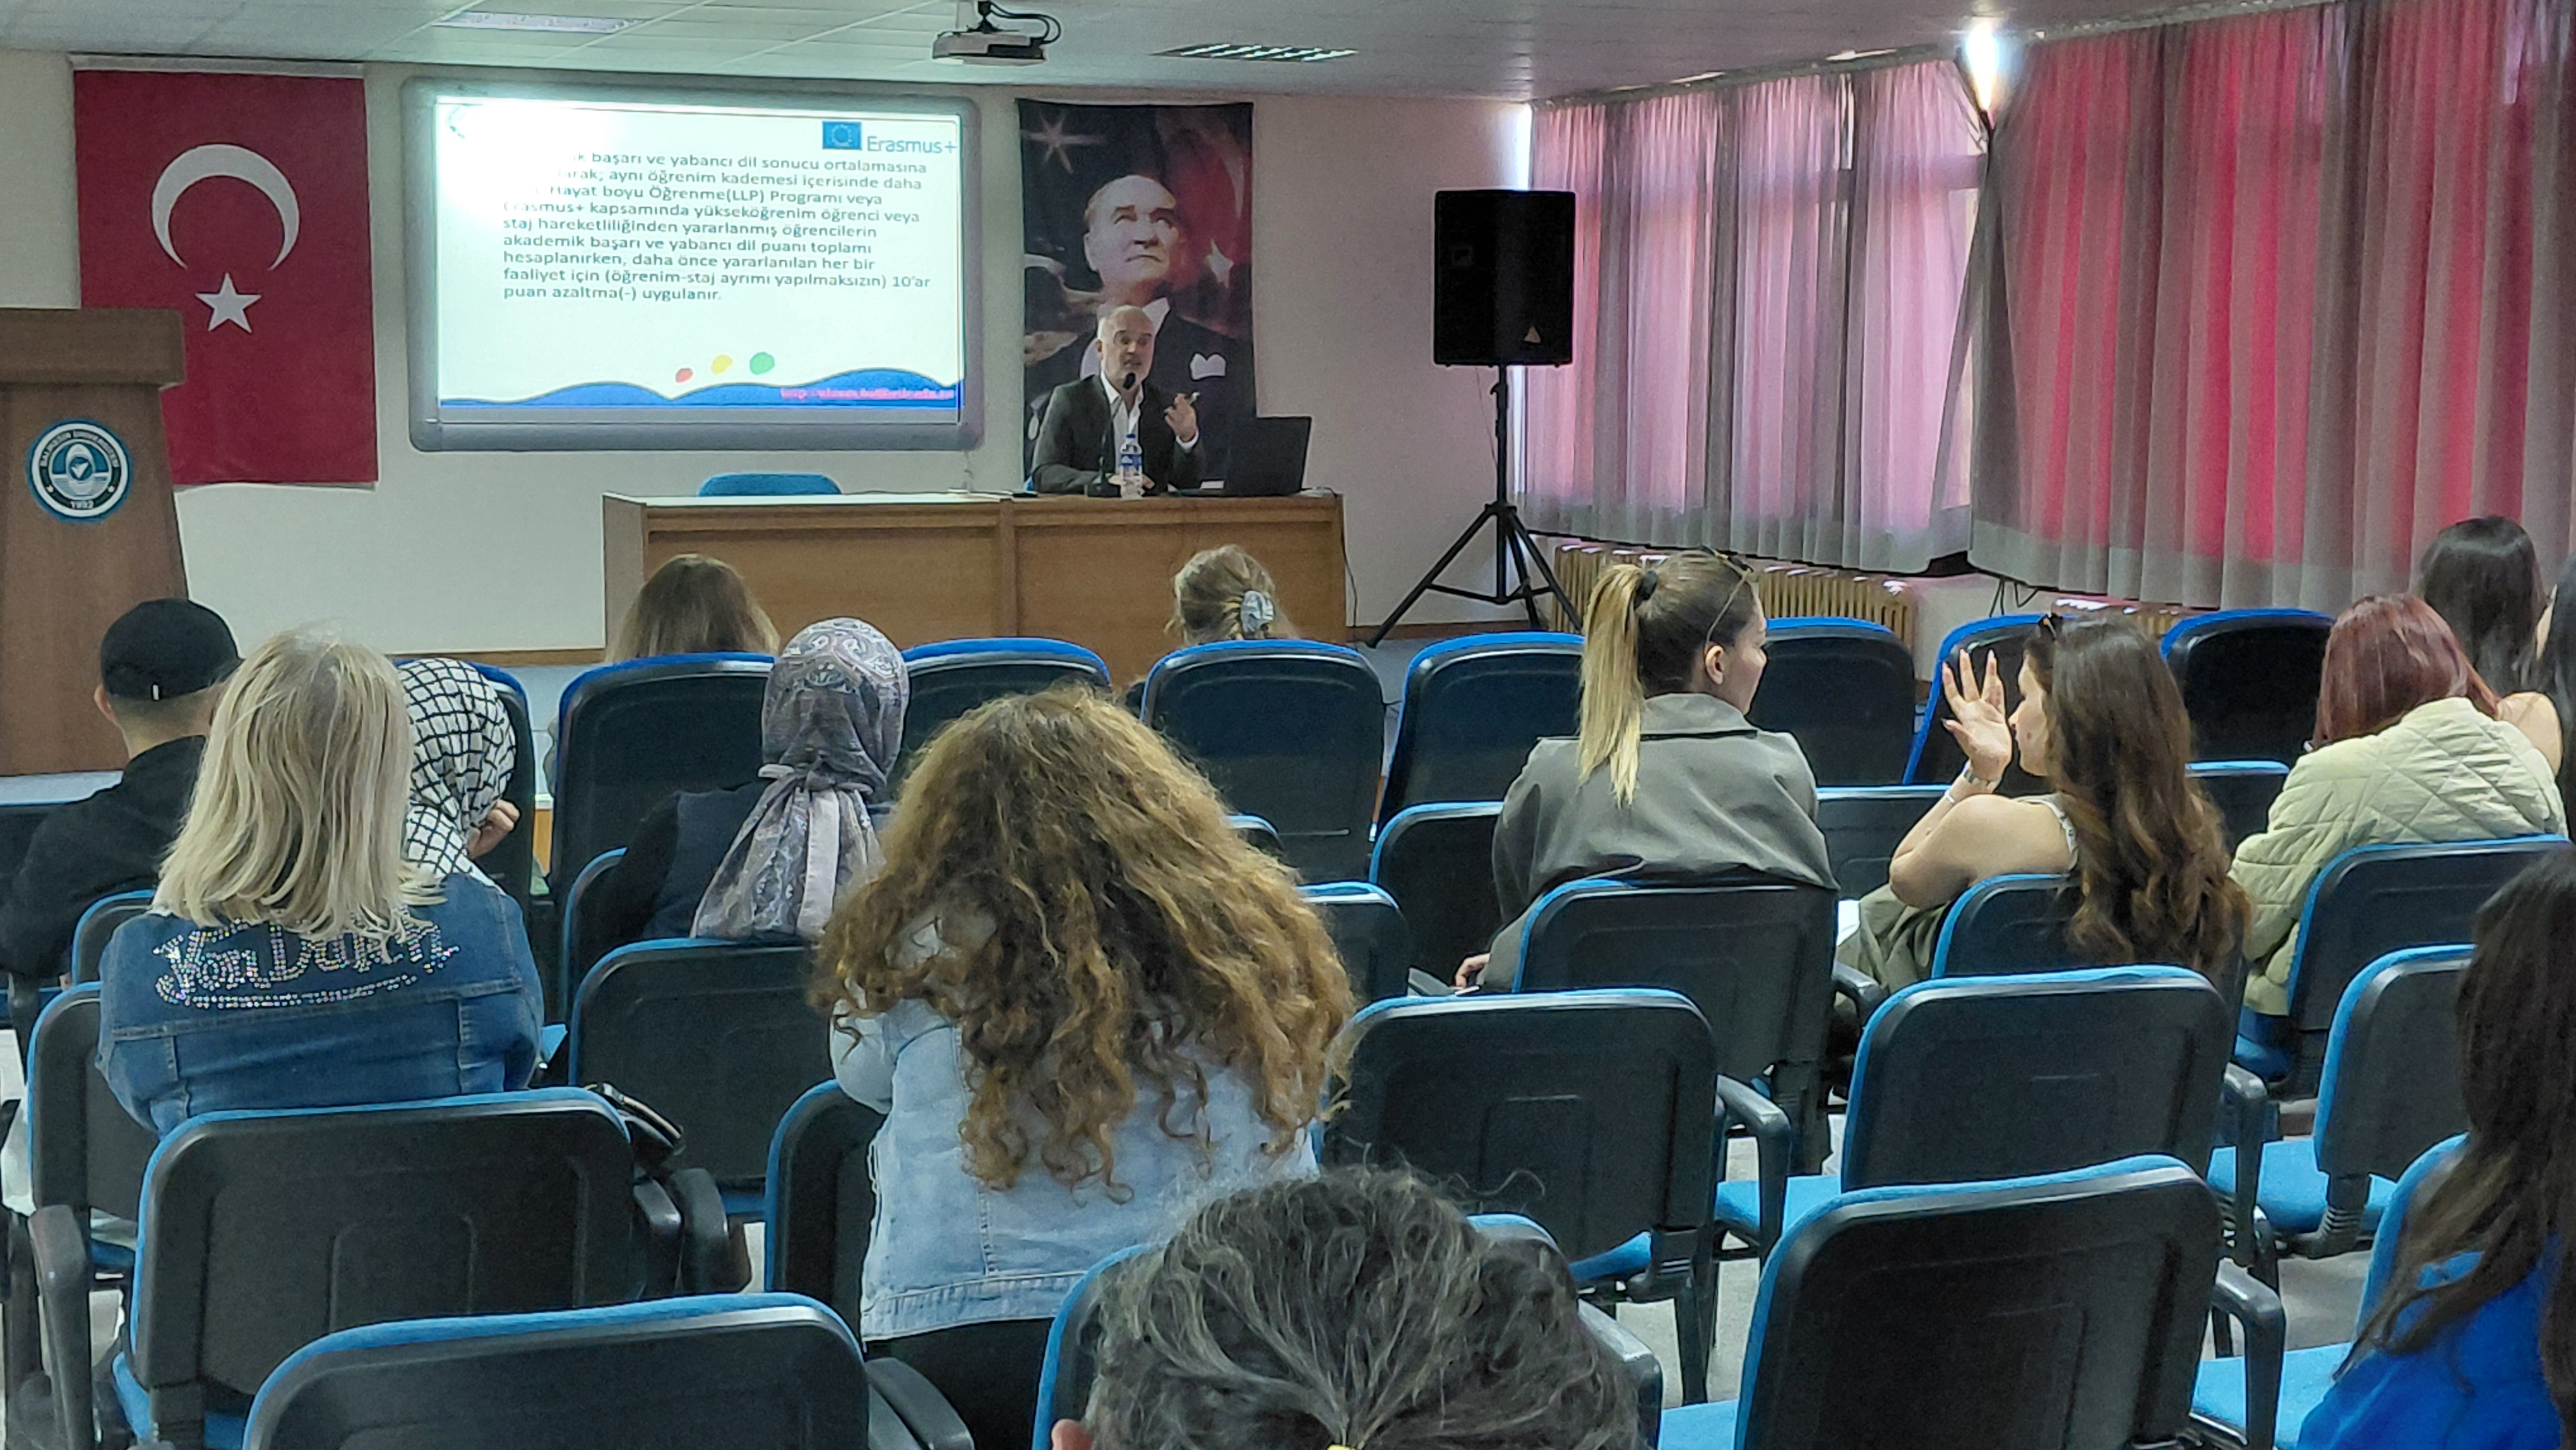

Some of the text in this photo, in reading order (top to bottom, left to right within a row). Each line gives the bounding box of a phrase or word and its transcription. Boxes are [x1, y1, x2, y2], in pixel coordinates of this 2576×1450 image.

[866, 135, 958, 154] Erasmus+
[592, 152, 642, 166] başarı
[646, 155, 665, 165] ve
[669, 153, 733, 168] yabancı
[737, 155, 757, 168] dil
[761, 159, 820, 170] sonucu
[823, 159, 927, 174] ortalamasına
[609, 171, 643, 184] aynı
[647, 169, 717, 184] öğrenim
[721, 172, 797, 186] kademesi
[802, 174, 880, 189] içerisinde
[883, 177, 922, 190] daha
[602, 185, 644, 201] boyu
[648, 184, 765, 203] Öğrenme(LLP)
[770, 189, 843, 206] Programı
[846, 195, 883, 208] veya
[590, 202, 689, 217] kapsamında
[693, 204, 816, 221] yükseköğrenim
[820, 207, 880, 223] öğrenci
[883, 212, 920, 225] veya
[503, 218, 877, 239] staj hareketliliğinden yararlanmış öğrencilerin
[503, 234, 872, 256] akademik başarı ve yabancı dil puanı toplamı
[631, 253, 674, 266] daha
[677, 255, 719, 267] önce
[722, 255, 818, 270] yararlanılan
[821, 257, 850, 270] her
[853, 258, 876, 270] bir
[503, 267, 566, 284] faaliyet
[571, 268, 600, 284] için
[720, 274, 771, 287] ayrımı
[774, 273, 887, 290] yapılmaksızın)
[503, 287, 547, 300] puan
[552, 285, 637, 302] azaltma(-)
